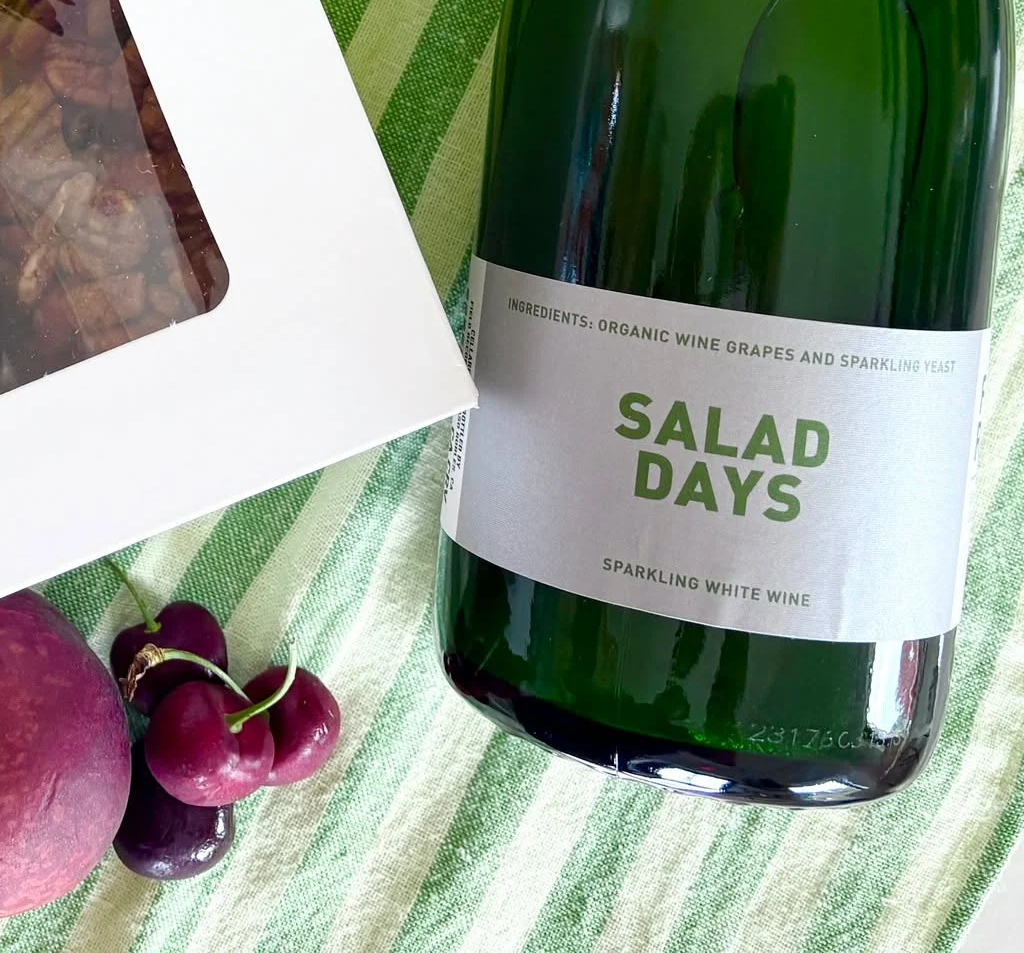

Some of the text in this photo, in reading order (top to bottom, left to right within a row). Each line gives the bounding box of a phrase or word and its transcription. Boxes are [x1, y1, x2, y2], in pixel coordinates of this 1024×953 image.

[508, 297, 957, 374] INGREDIENTS: ORGANIC WINE GRAPES AND SPARKLING YEAST
[614, 392, 830, 468] SALAD
[634, 450, 802, 523] DAYS
[602, 557, 810, 607] SPARKLING WHITE WINE
